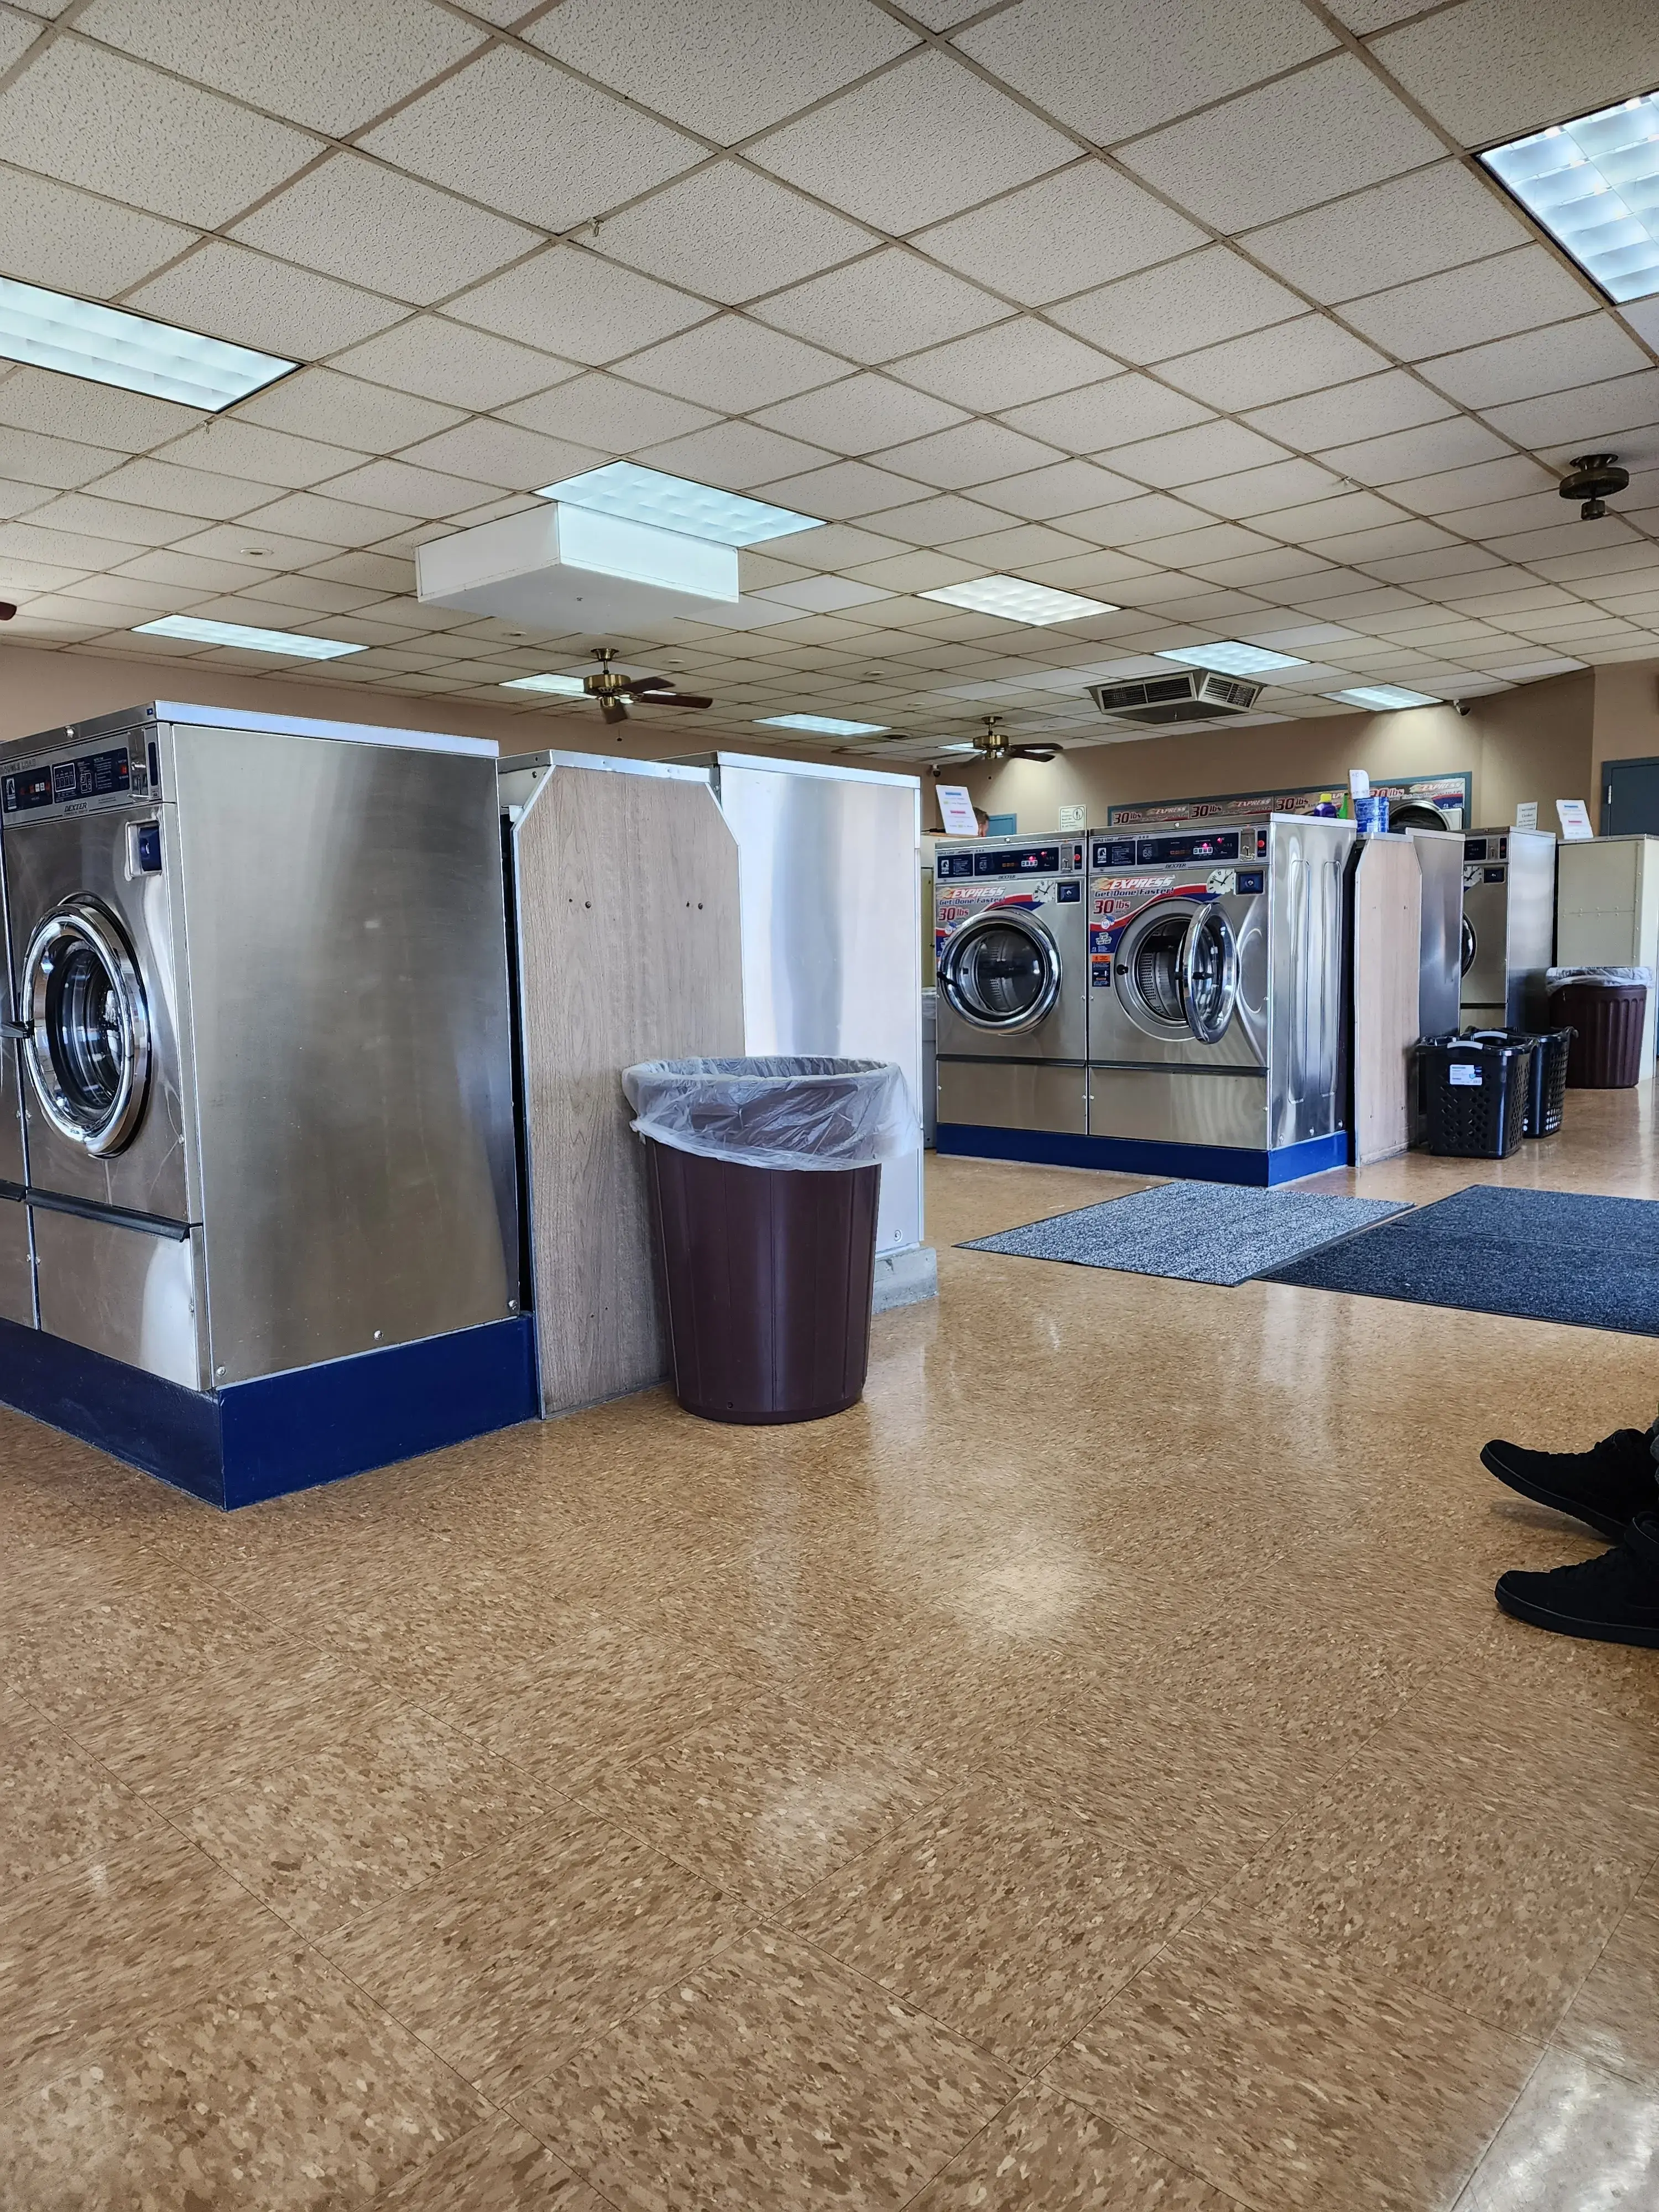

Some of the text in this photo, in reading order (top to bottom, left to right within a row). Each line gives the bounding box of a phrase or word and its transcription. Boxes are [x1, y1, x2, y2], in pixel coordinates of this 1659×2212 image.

[1390, 788, 1403, 796] lbs
[64, 802, 87, 812] DEXTER
[1238, 798, 1271, 807] EXPRESS
[1276, 797, 1295, 811] 30
[1296, 797, 1308, 805] lbs
[1156, 806, 1187, 814] EXPRESS
[1191, 805, 1209, 818] 30
[1210, 804, 1222, 812] lbs
[1113, 812, 1129, 824] 30
[1109, 874, 1176, 890] EXPRESS
[952, 887, 1006, 899] EXPRESS
[1094, 899, 1130, 914] 30 lbs
[938, 907, 969, 921] 30 lbs
